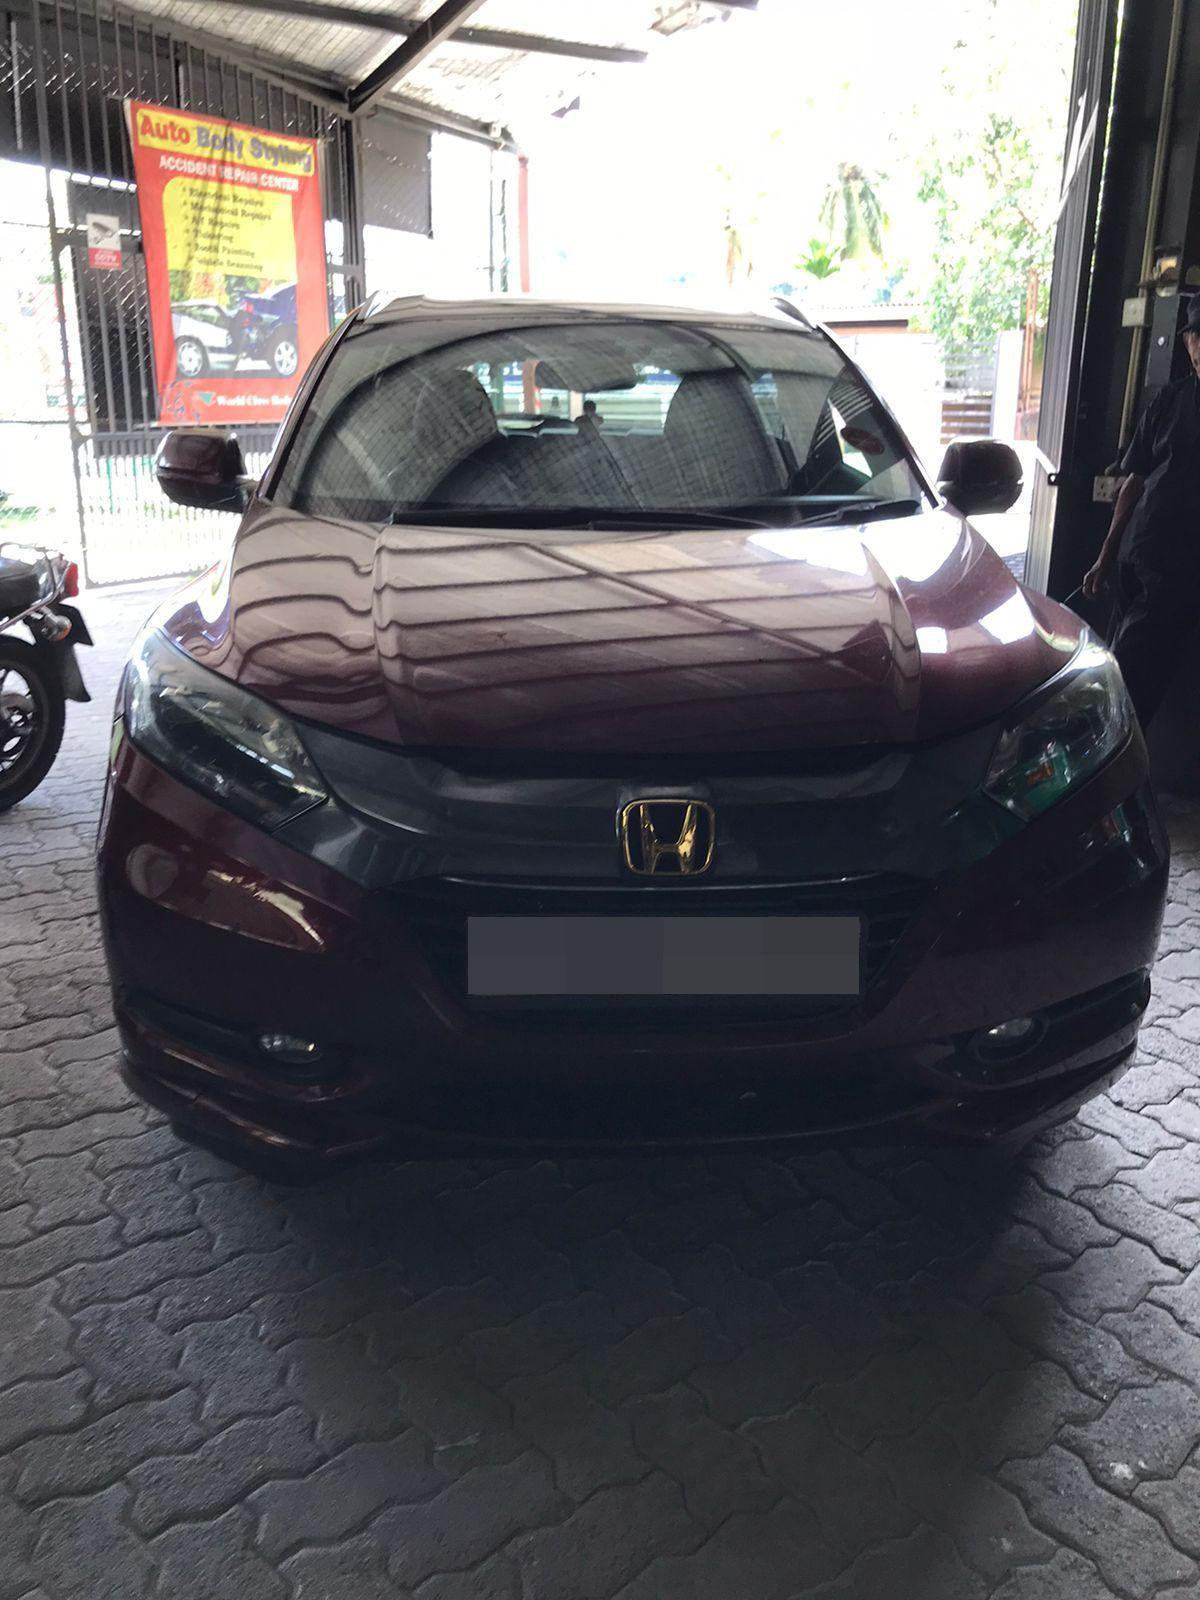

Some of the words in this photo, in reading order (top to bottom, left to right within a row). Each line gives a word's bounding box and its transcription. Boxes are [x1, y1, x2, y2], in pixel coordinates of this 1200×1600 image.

[140, 114, 191, 145] Auto
[196, 126, 243, 159] Body
[159, 155, 217, 177] ACCIDENT
